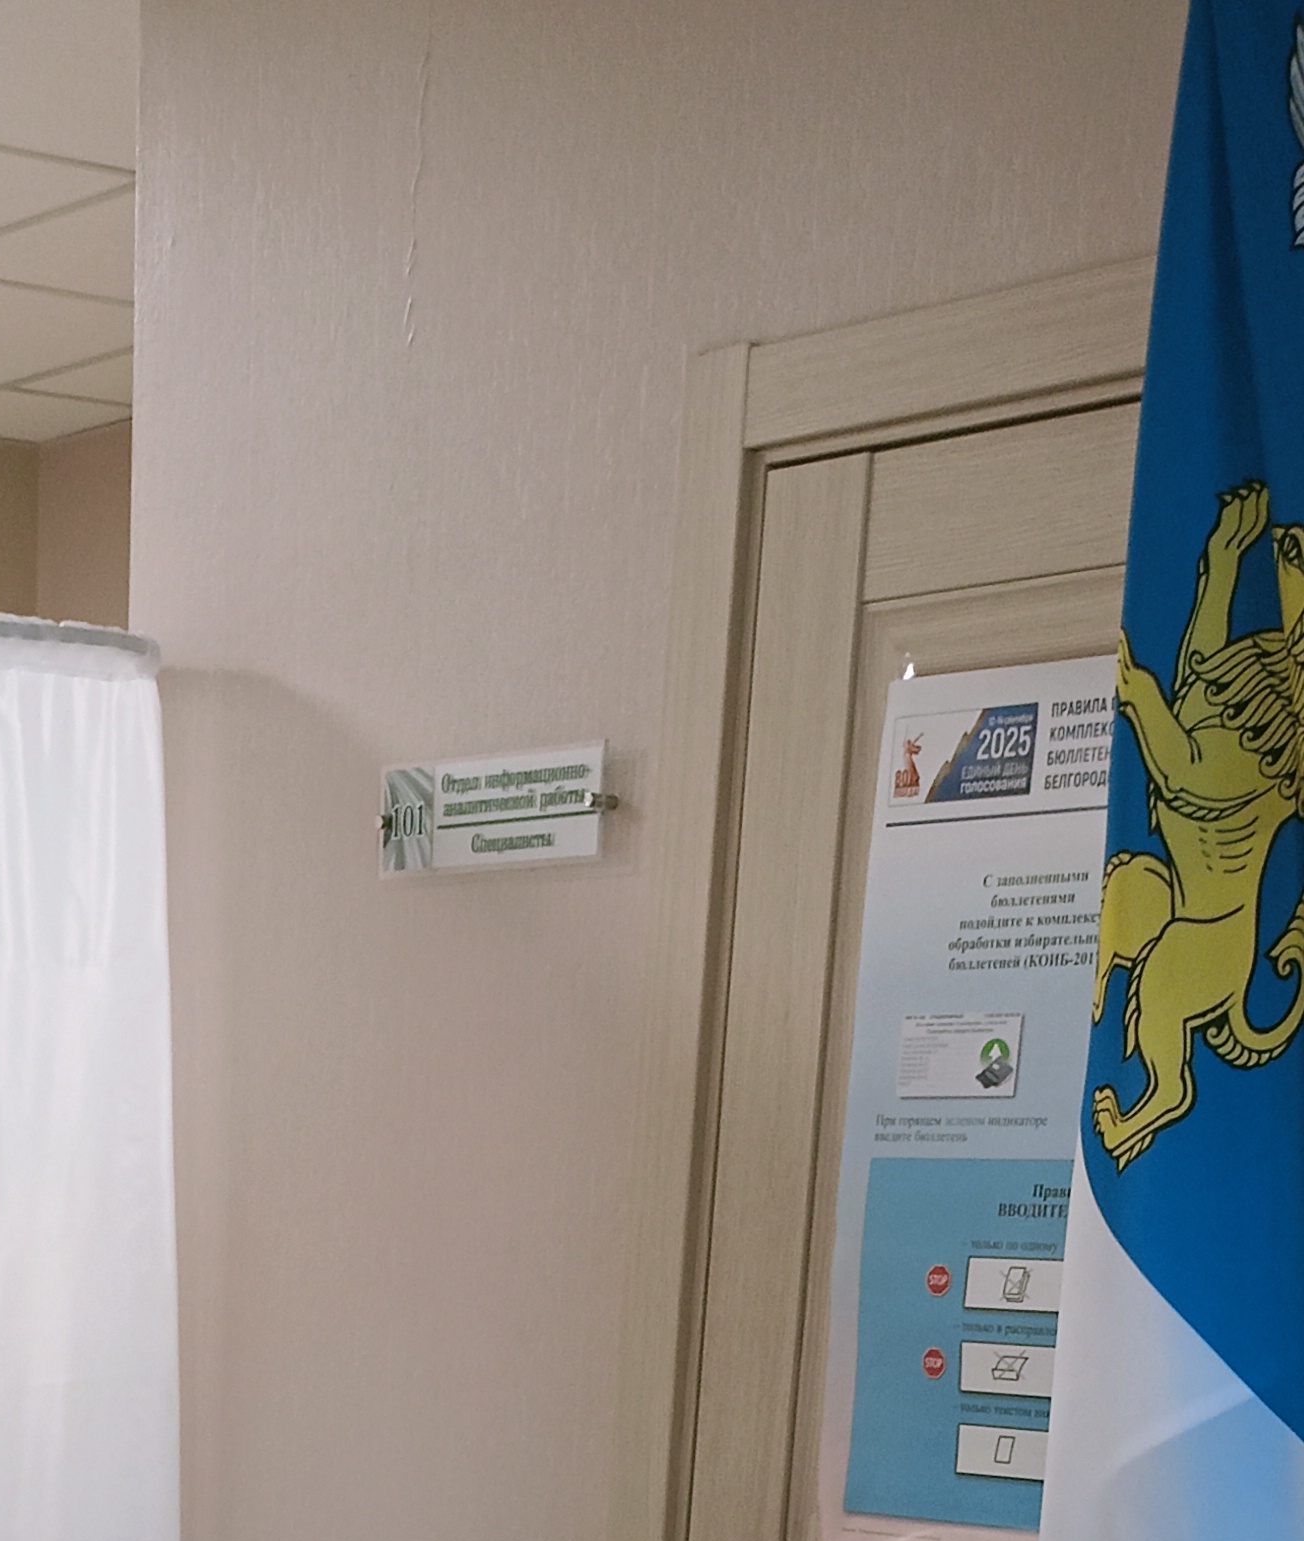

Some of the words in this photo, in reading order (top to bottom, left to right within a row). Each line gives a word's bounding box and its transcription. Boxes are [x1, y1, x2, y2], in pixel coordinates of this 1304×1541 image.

[1051, 696, 1107, 717] ПРАВИЛА
[976, 725, 1032, 761] 2025
[441, 772, 481, 793] Отдел
[484, 763, 592, 791] информационно-
[391, 804, 424, 838] 101
[471, 832, 555, 855] Специалисты
[983, 874, 993, 888] С
[996, 872, 1089, 887] заполненными
[990, 893, 1075, 908] бюллетенями
[959, 915, 1022, 930] подойдите
[1026, 916, 1034, 926] к
[948, 936, 1011, 953] обработки
[948, 957, 1020, 971] бюллетеней
[1024, 951, 1095, 970] (КОИБ-201
[924, 1356, 943, 1369] STOP
